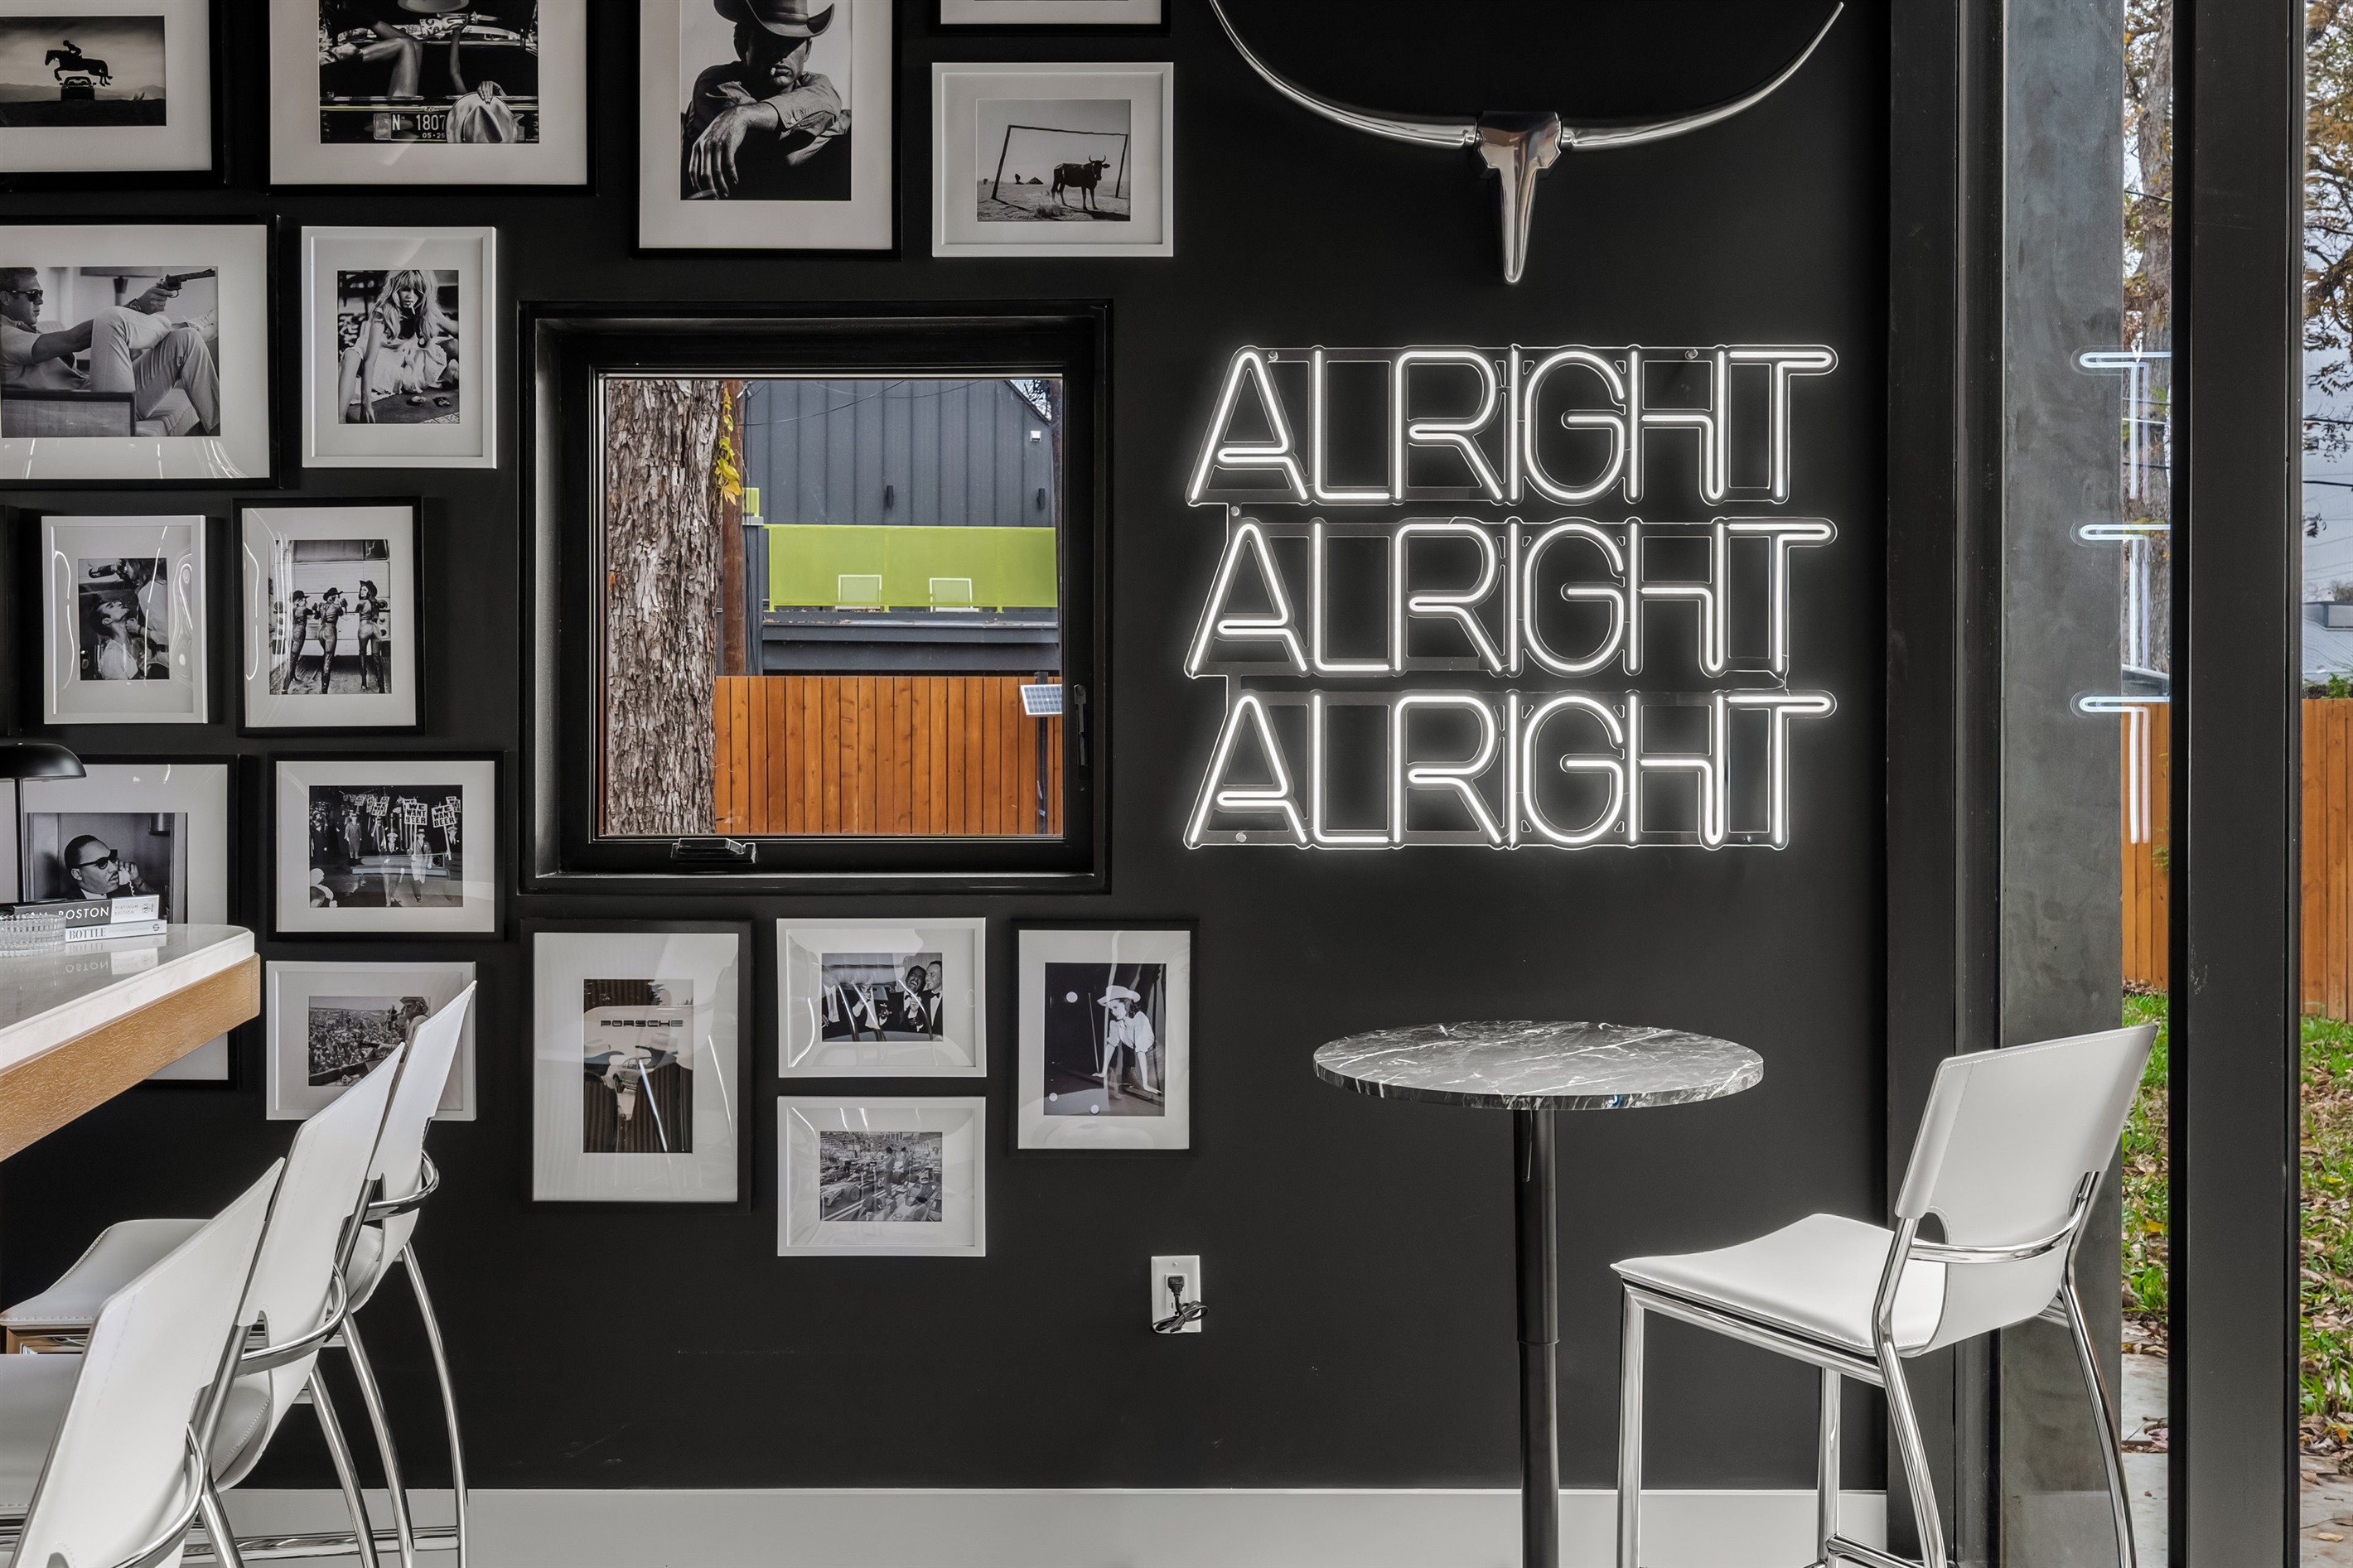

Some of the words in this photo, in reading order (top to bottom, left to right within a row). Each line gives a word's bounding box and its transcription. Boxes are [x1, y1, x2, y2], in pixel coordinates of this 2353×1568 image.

[1190, 349, 1834, 501] ALRIGHT
[1190, 521, 1834, 673] ALRIGHT
[1190, 693, 1834, 847] ALRIGHT
[433, 810, 452, 820] WANT
[434, 817, 455, 827] BEER
[69, 928, 106, 940] BOTTLE
